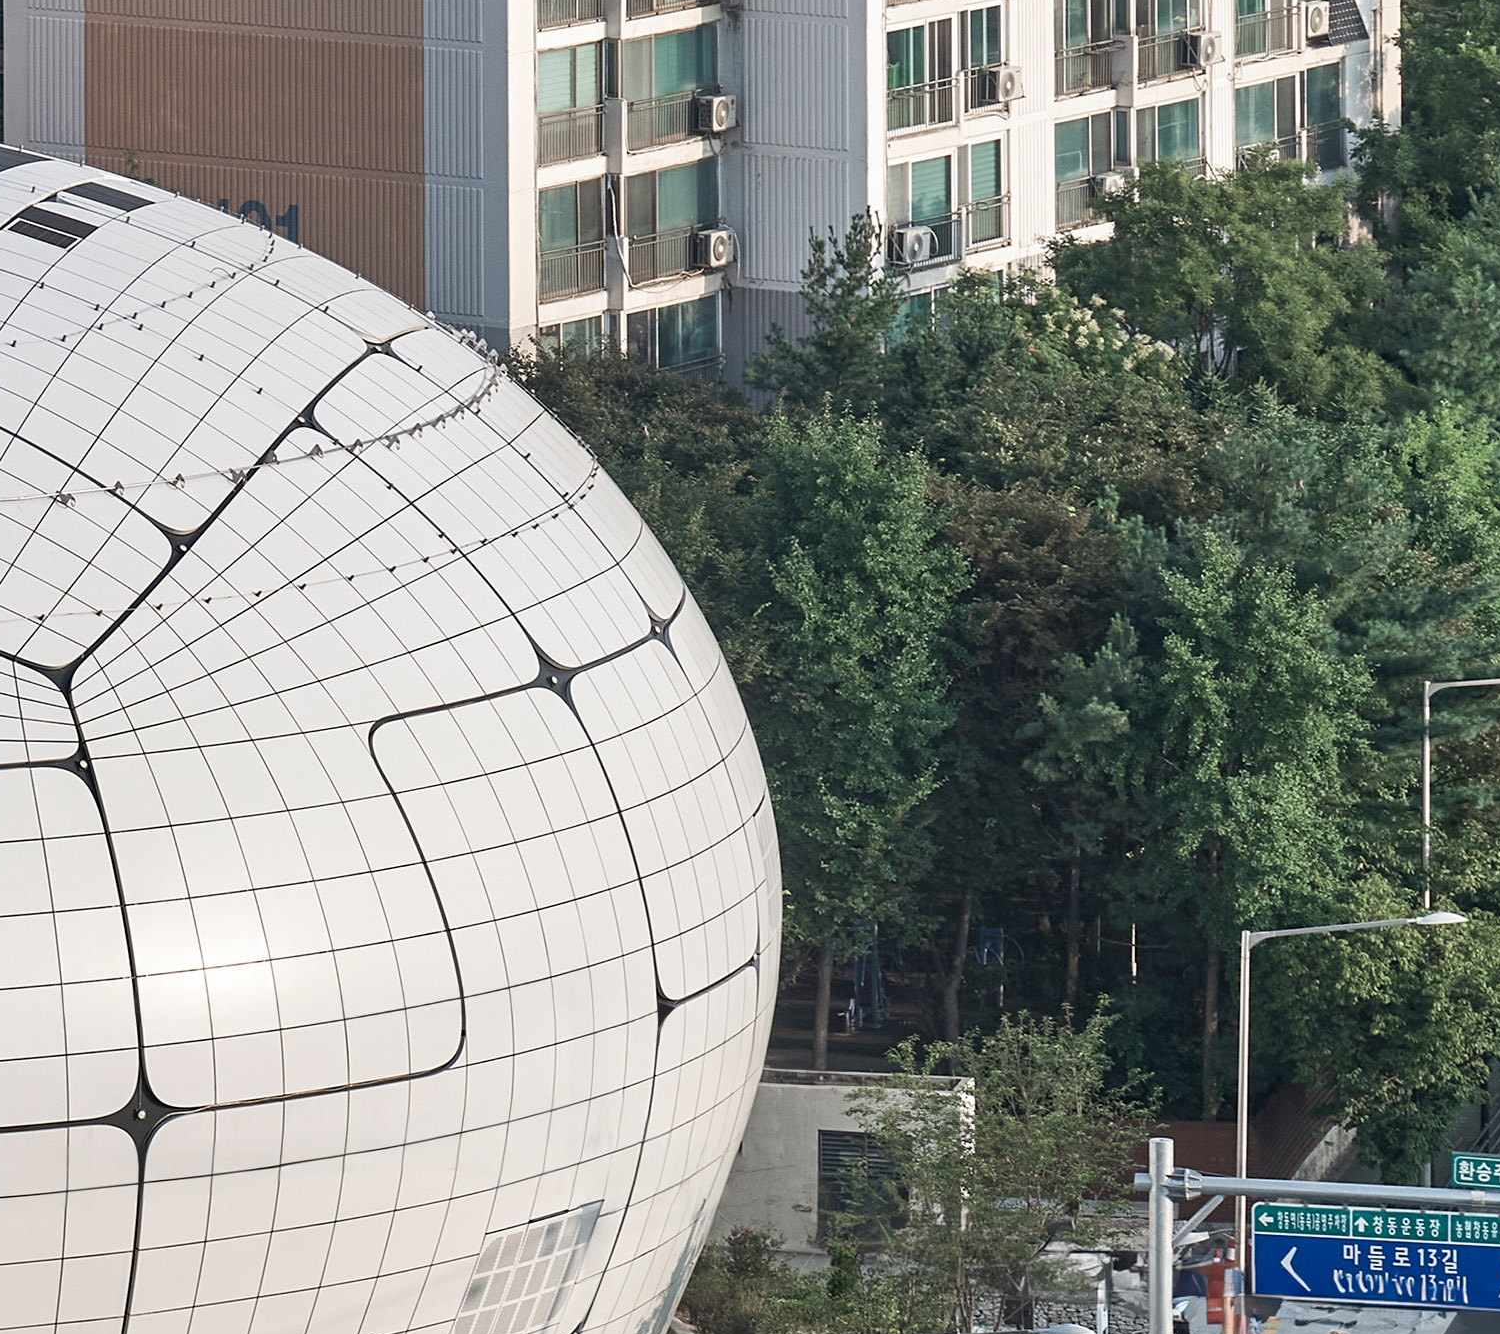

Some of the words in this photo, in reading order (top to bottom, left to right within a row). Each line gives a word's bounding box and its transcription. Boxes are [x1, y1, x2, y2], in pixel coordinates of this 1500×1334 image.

[1372, 1215, 1441, 1238] 창동운동장
[1342, 1243, 1412, 1271] 마들로
[1417, 1247, 1459, 1275] 13길
